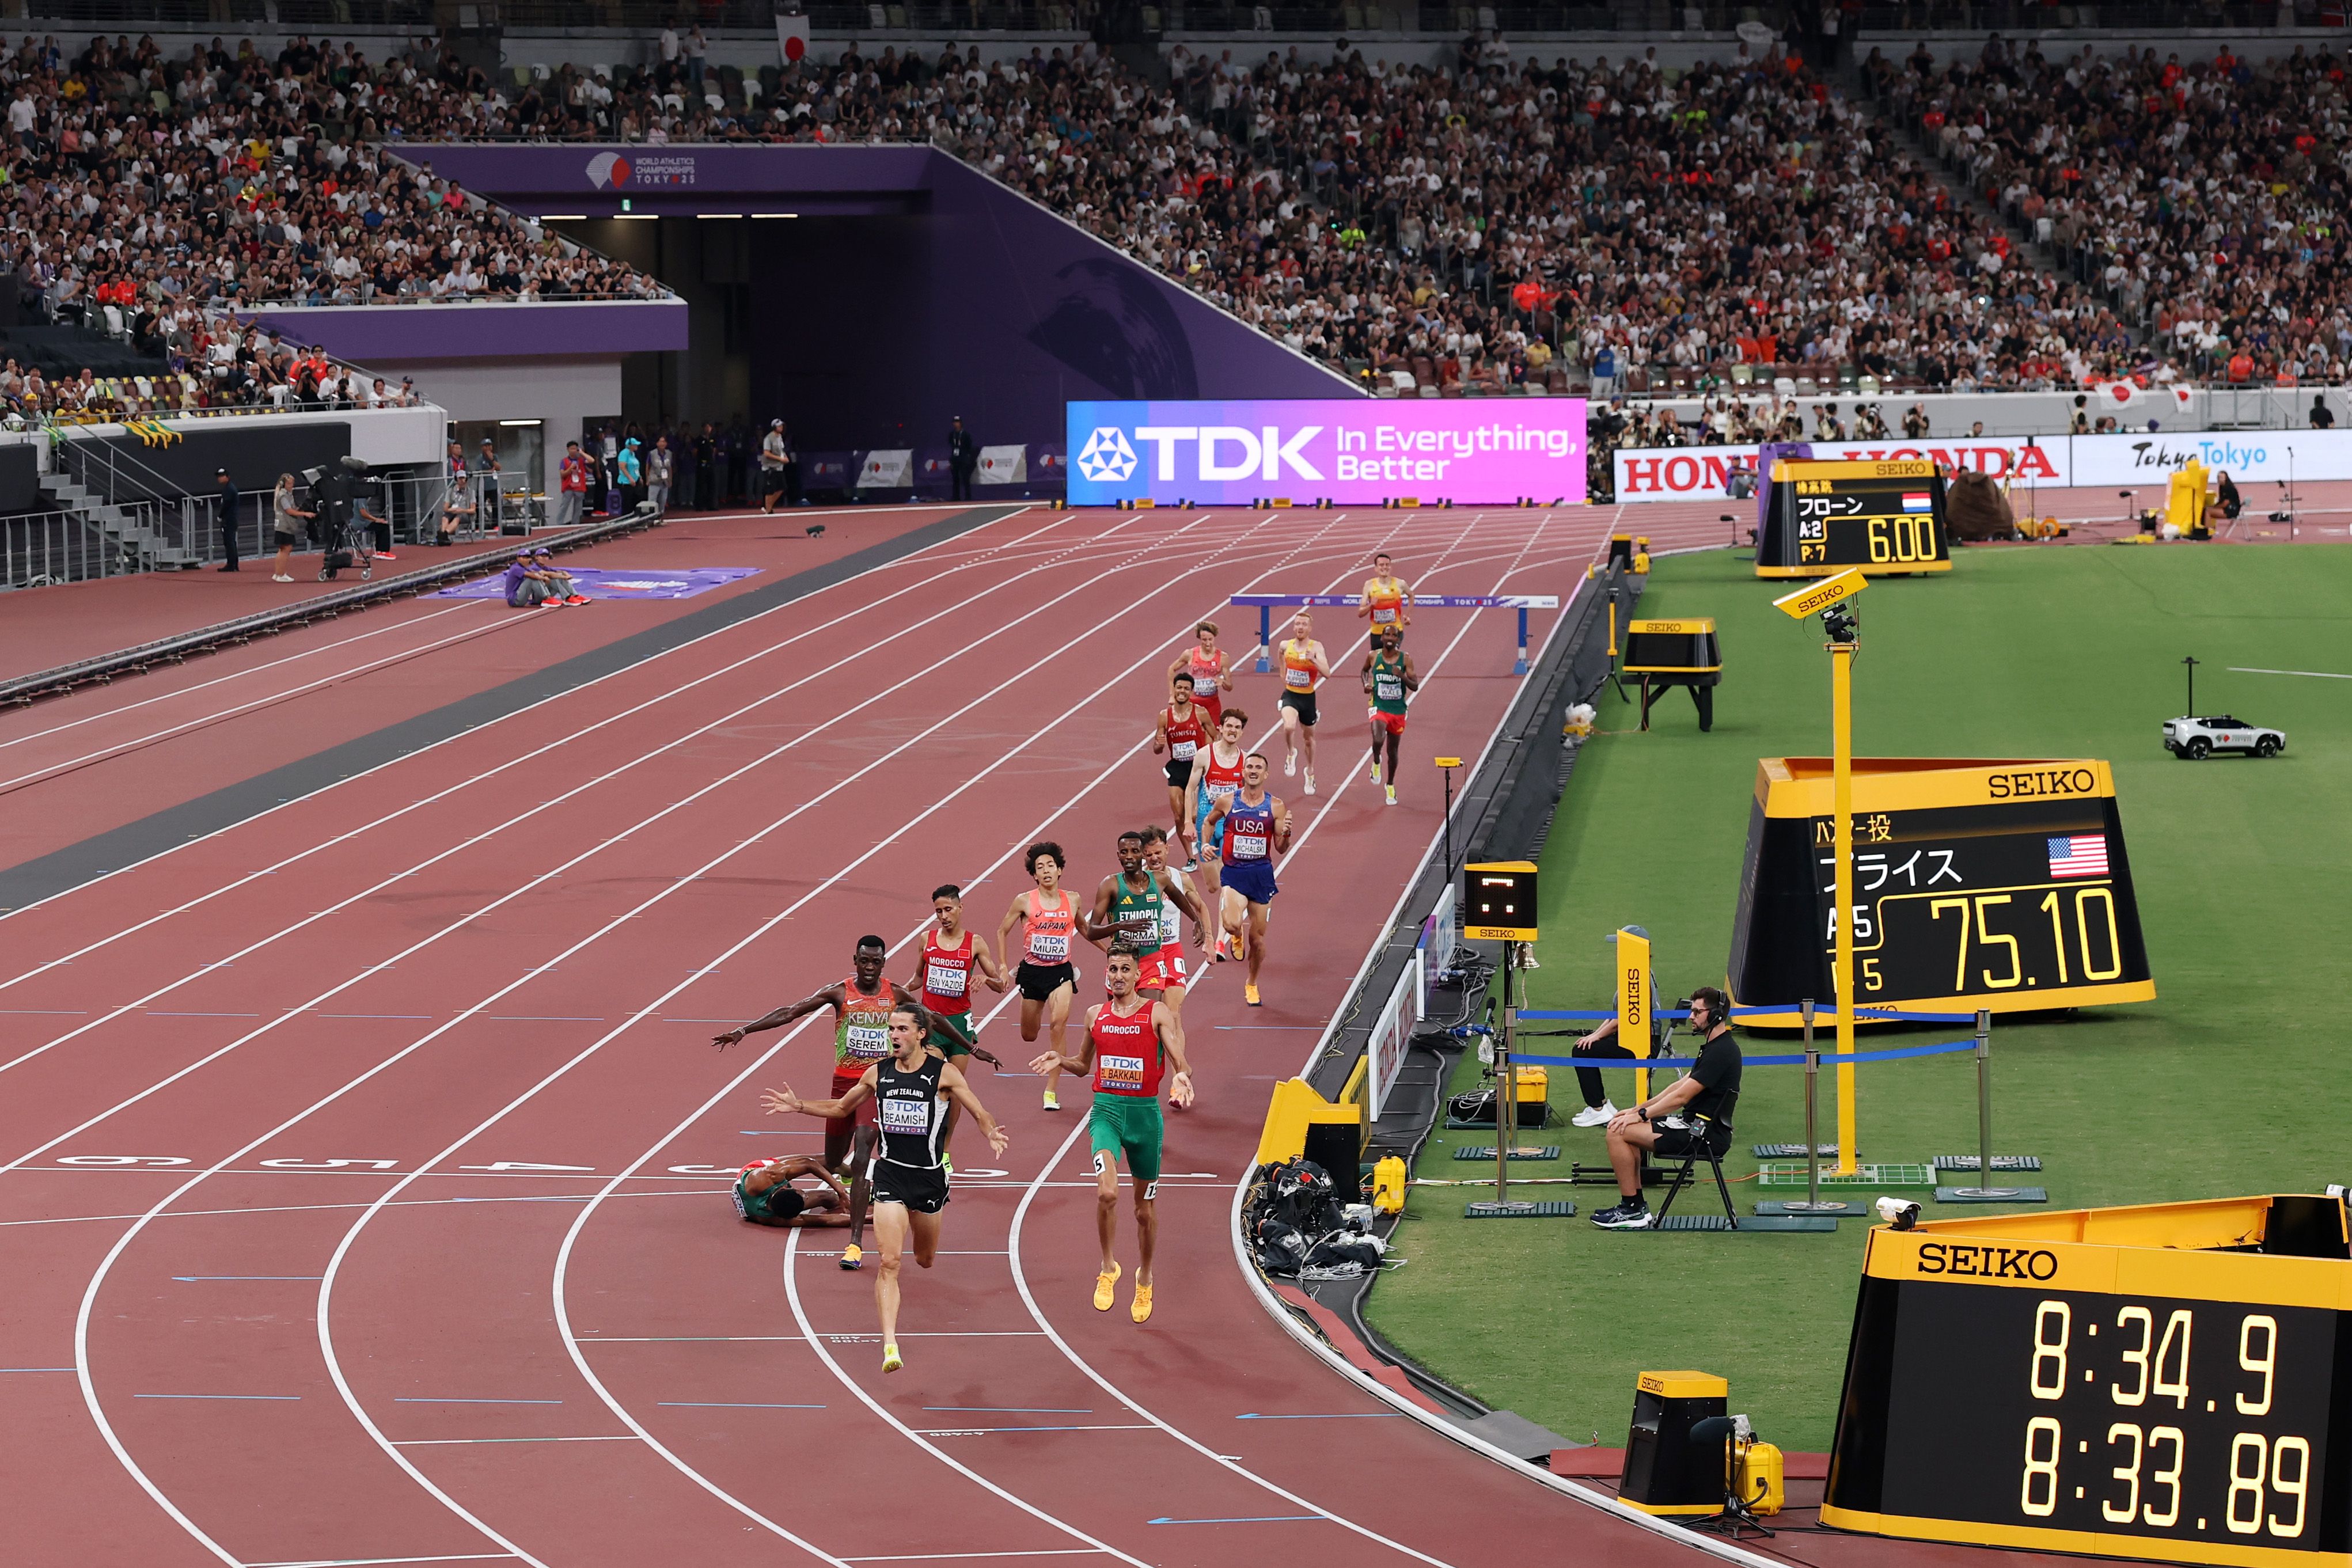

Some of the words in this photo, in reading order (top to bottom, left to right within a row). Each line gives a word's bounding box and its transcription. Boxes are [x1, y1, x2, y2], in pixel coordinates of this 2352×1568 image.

[635, 166, 695, 174] CHAMPIONSHIPS
[1336, 426, 1366, 451] In
[1376, 424, 1578, 460] Everything,
[1135, 426, 1325, 481] TDK
[2198, 441, 2266, 470] Tokyo
[1336, 455, 1450, 481] Better
[1876, 462, 1926, 476] SEIKO
[1798, 496, 1863, 516] フローン
[1868, 517, 1936, 563] 6.00
[1798, 585, 1843, 613] SEIKO
[1646, 623, 1681, 632] SEIKO
[1376, 673, 1401, 682] ETHIOPIA
[1170, 730, 1197, 738] TUNISIA
[1175, 749, 1195, 757] JAZIRI
[1989, 769, 2095, 798] SEIKO
[1235, 819, 1264, 834] USA
[1243, 837, 1264, 845] TDK
[1235, 844, 1265, 853] MICHALSKI
[1119, 908, 1158, 921] ETHIOPIA
[1035, 922, 1067, 930] JAPAN
[1122, 931, 1155, 940] GIRMA
[1480, 929, 1515, 938] SEIKO
[1930, 887, 2122, 992] 75.10
[1042, 937, 1065, 945] TDK
[1033, 944, 1065, 954] MIURA
[929, 956, 965, 967] MOROCCO
[938, 969, 963, 979] TDK
[928, 977, 940, 986] BEN
[941, 979, 963, 990] YAZIDE
[1628, 968, 1640, 1025] SEIKO
[848, 1012, 888, 1024] KENYA
[860, 1030, 885, 1039] TDK
[1102, 1025, 1140, 1034] MOROCCO
[849, 1038, 885, 1050] SEREM
[1110, 1058, 1140, 1069] TDK
[1379, 1022, 1397, 1097] HONDA
[1108, 1069, 1141, 1081] BAKKALI
[886, 1088, 899, 1098] NEW
[900, 1088, 924, 1098] ZEALAND
[894, 1102, 924, 1113] TDK
[885, 1113, 925, 1125] BEAMISH
[1917, 1243, 2058, 1282] SEIKO
[2030, 1300, 2278, 1417] 8:34.9
[1641, 1377, 1664, 1392] SEIKO
[2020, 1415, 2310, 1539] 8:33.89
